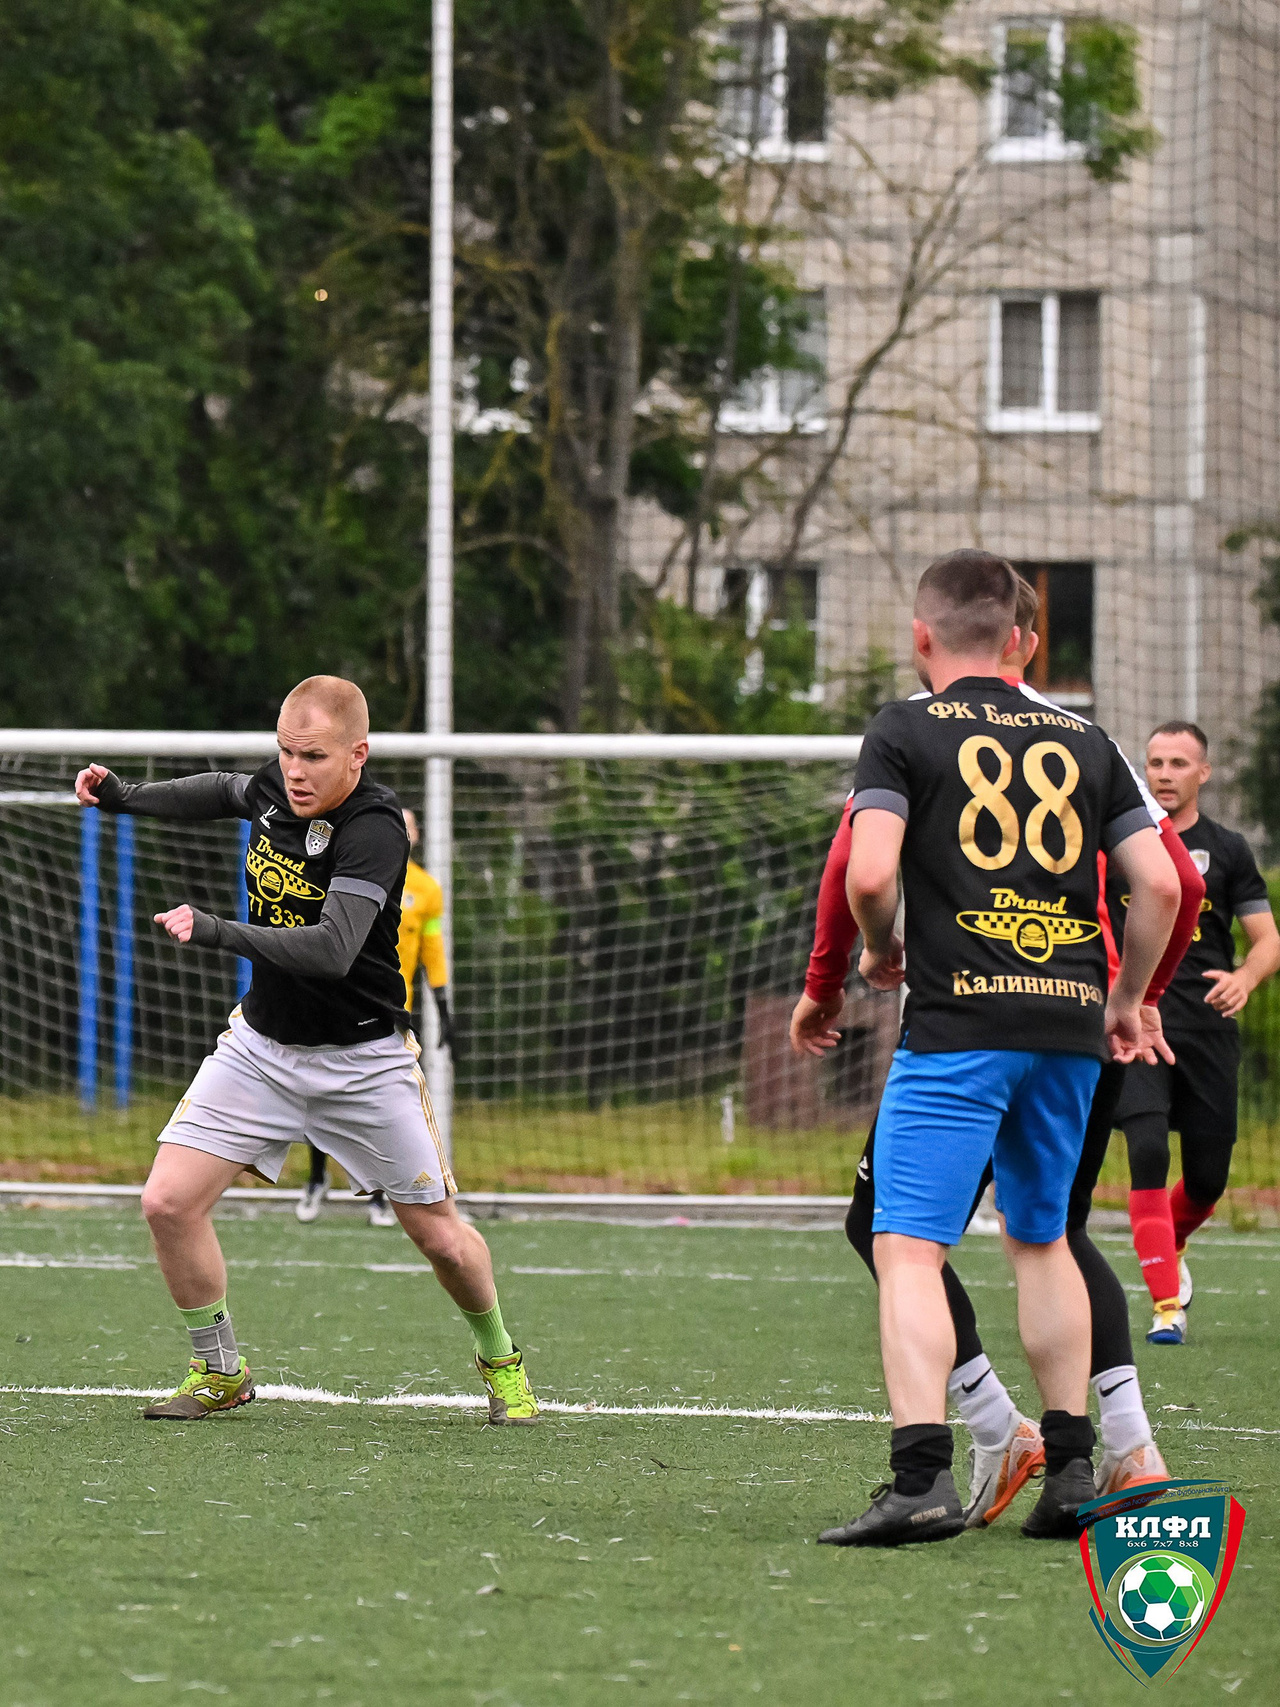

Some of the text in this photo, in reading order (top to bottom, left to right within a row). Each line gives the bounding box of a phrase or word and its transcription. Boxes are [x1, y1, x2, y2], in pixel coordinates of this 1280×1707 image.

[927, 701, 1086, 733] ФК Бастион
[958, 735, 1083, 875] 88
[256, 834, 306, 875] Brand
[990, 888, 1067, 914] Brand
[951, 970, 1104, 1007] Калинингра
